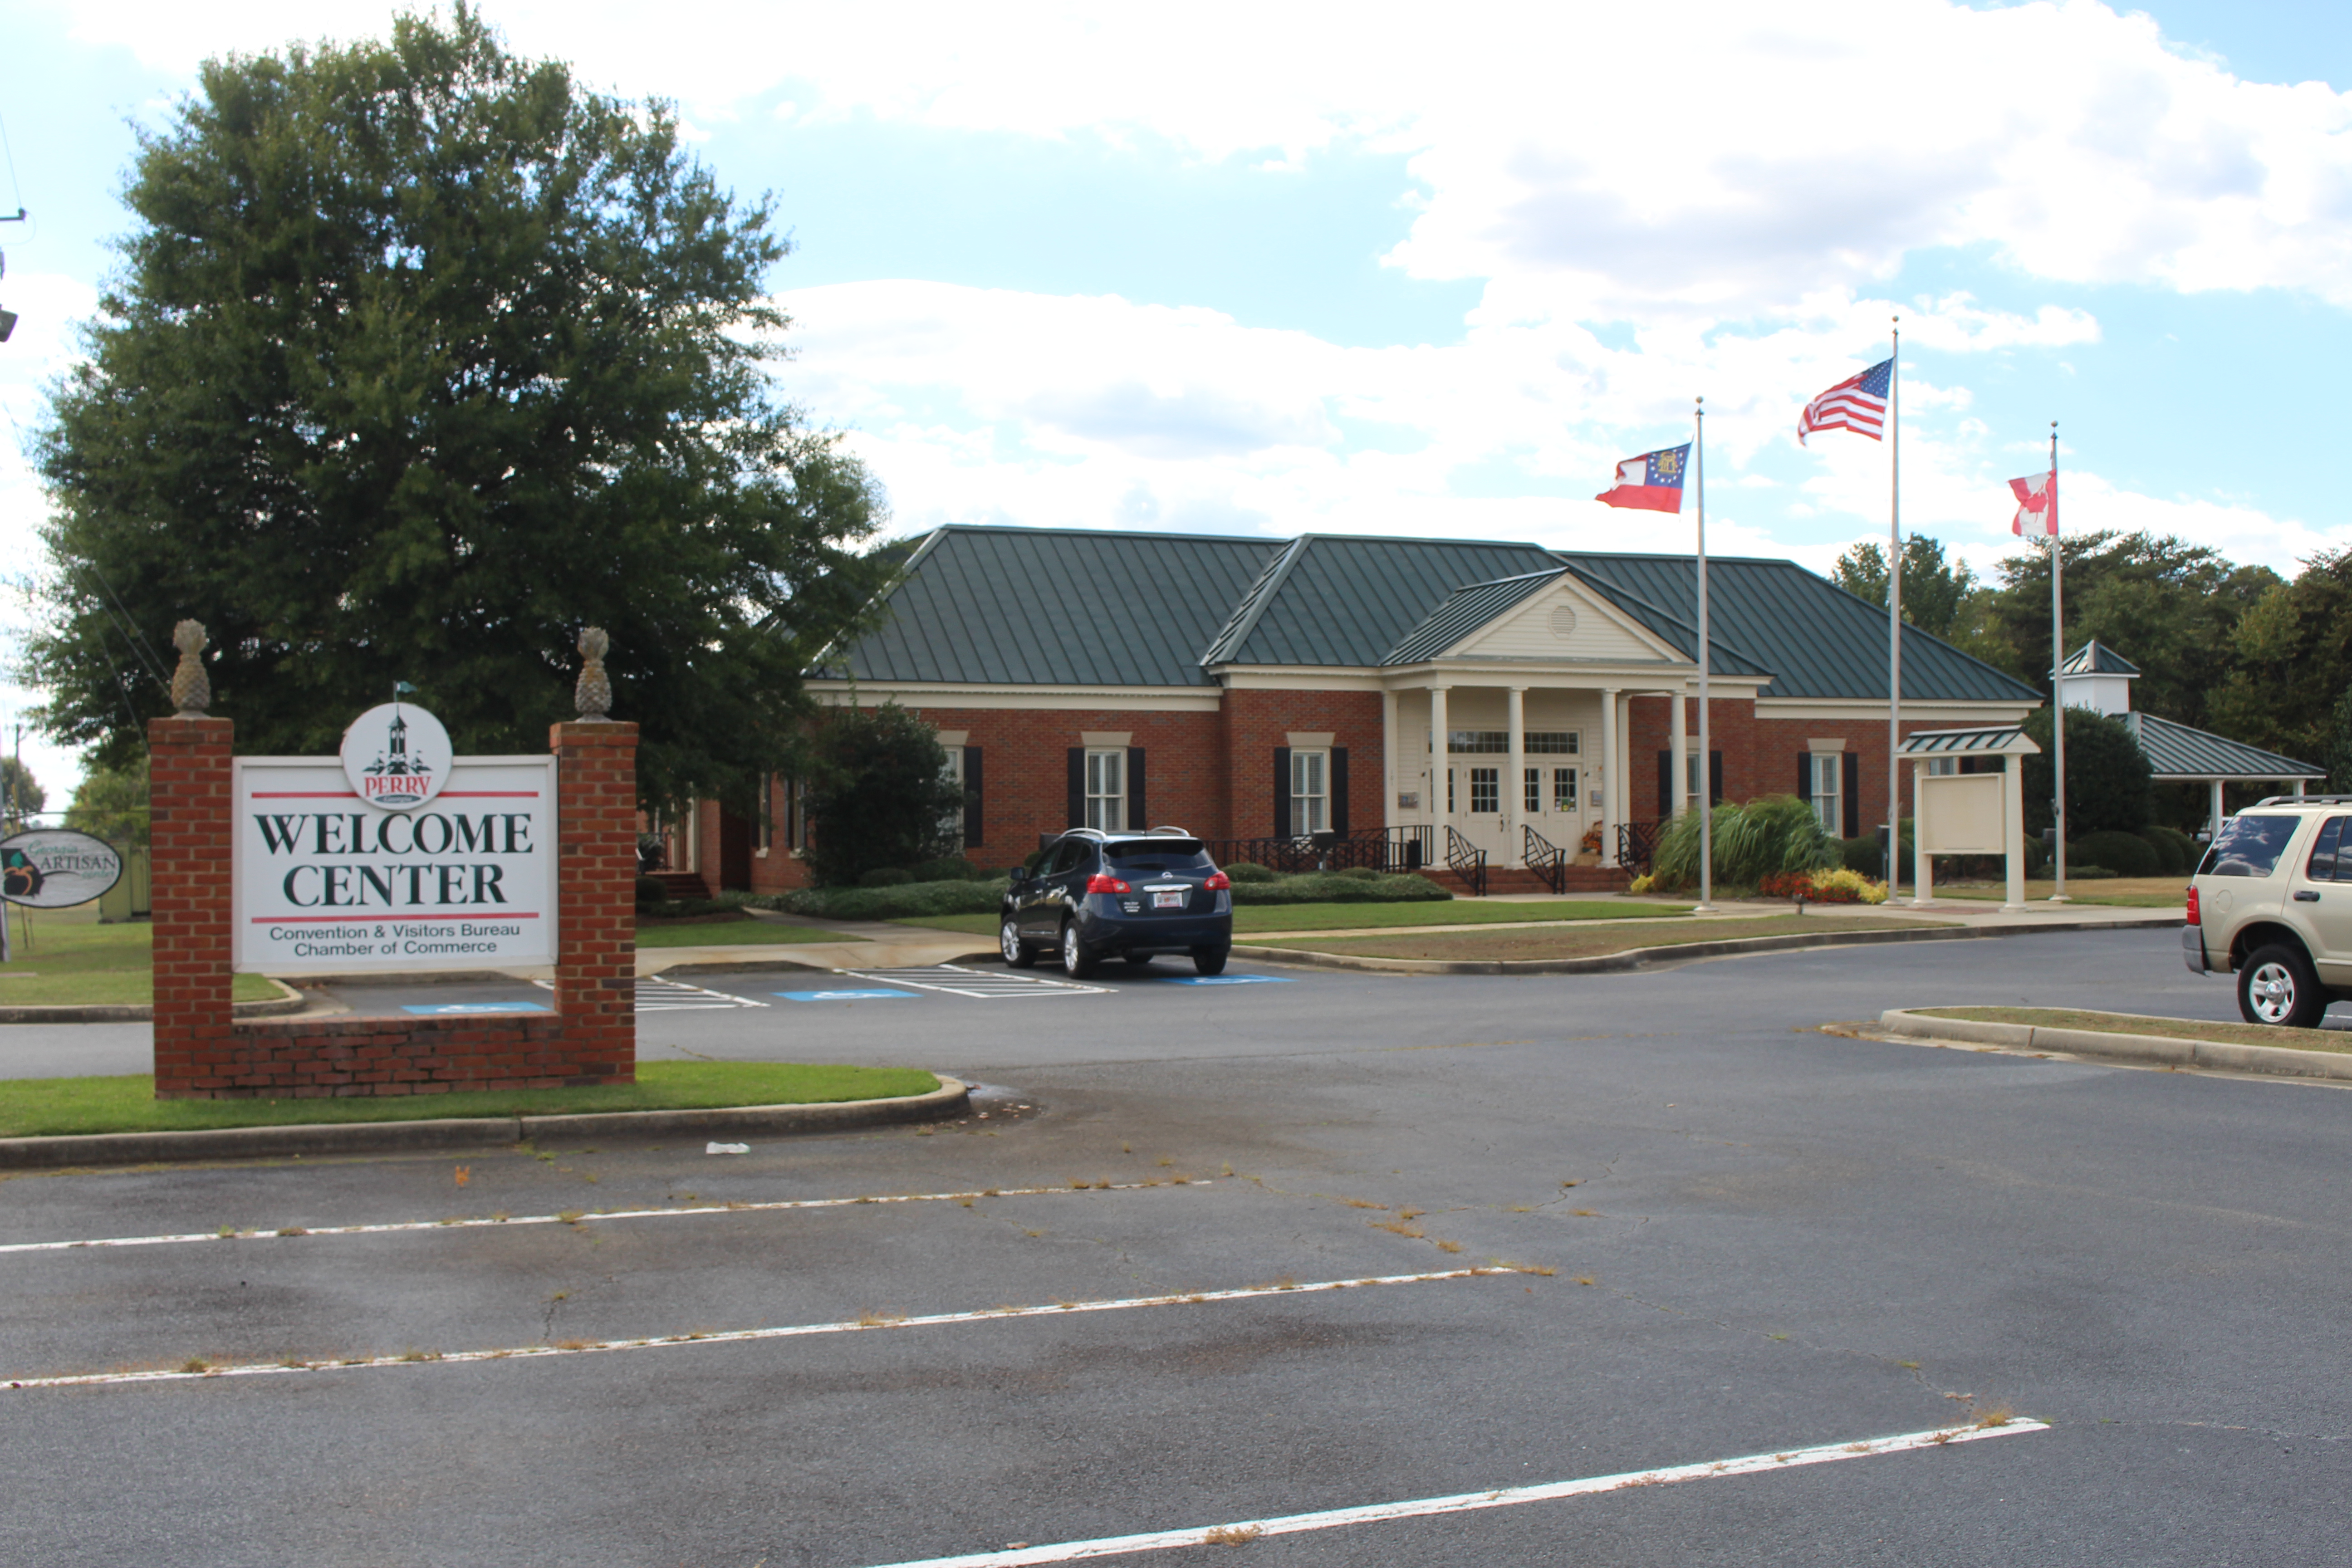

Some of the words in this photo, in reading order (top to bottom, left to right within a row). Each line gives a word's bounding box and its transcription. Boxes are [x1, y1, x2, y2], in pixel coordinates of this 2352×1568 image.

[365, 775, 431, 797] PERRY
[253, 813, 534, 855] WELCOME
[40, 855, 117, 870] ARTISAN
[283, 863, 509, 907] CENTER
[270, 925, 368, 941] Convention
[374, 925, 385, 938] &
[392, 924, 456, 938] Visitors
[461, 923, 520, 936] Bureau
[294, 942, 374, 956] Chamber
[380, 941, 397, 954] of
[404, 941, 497, 954] Commerce
